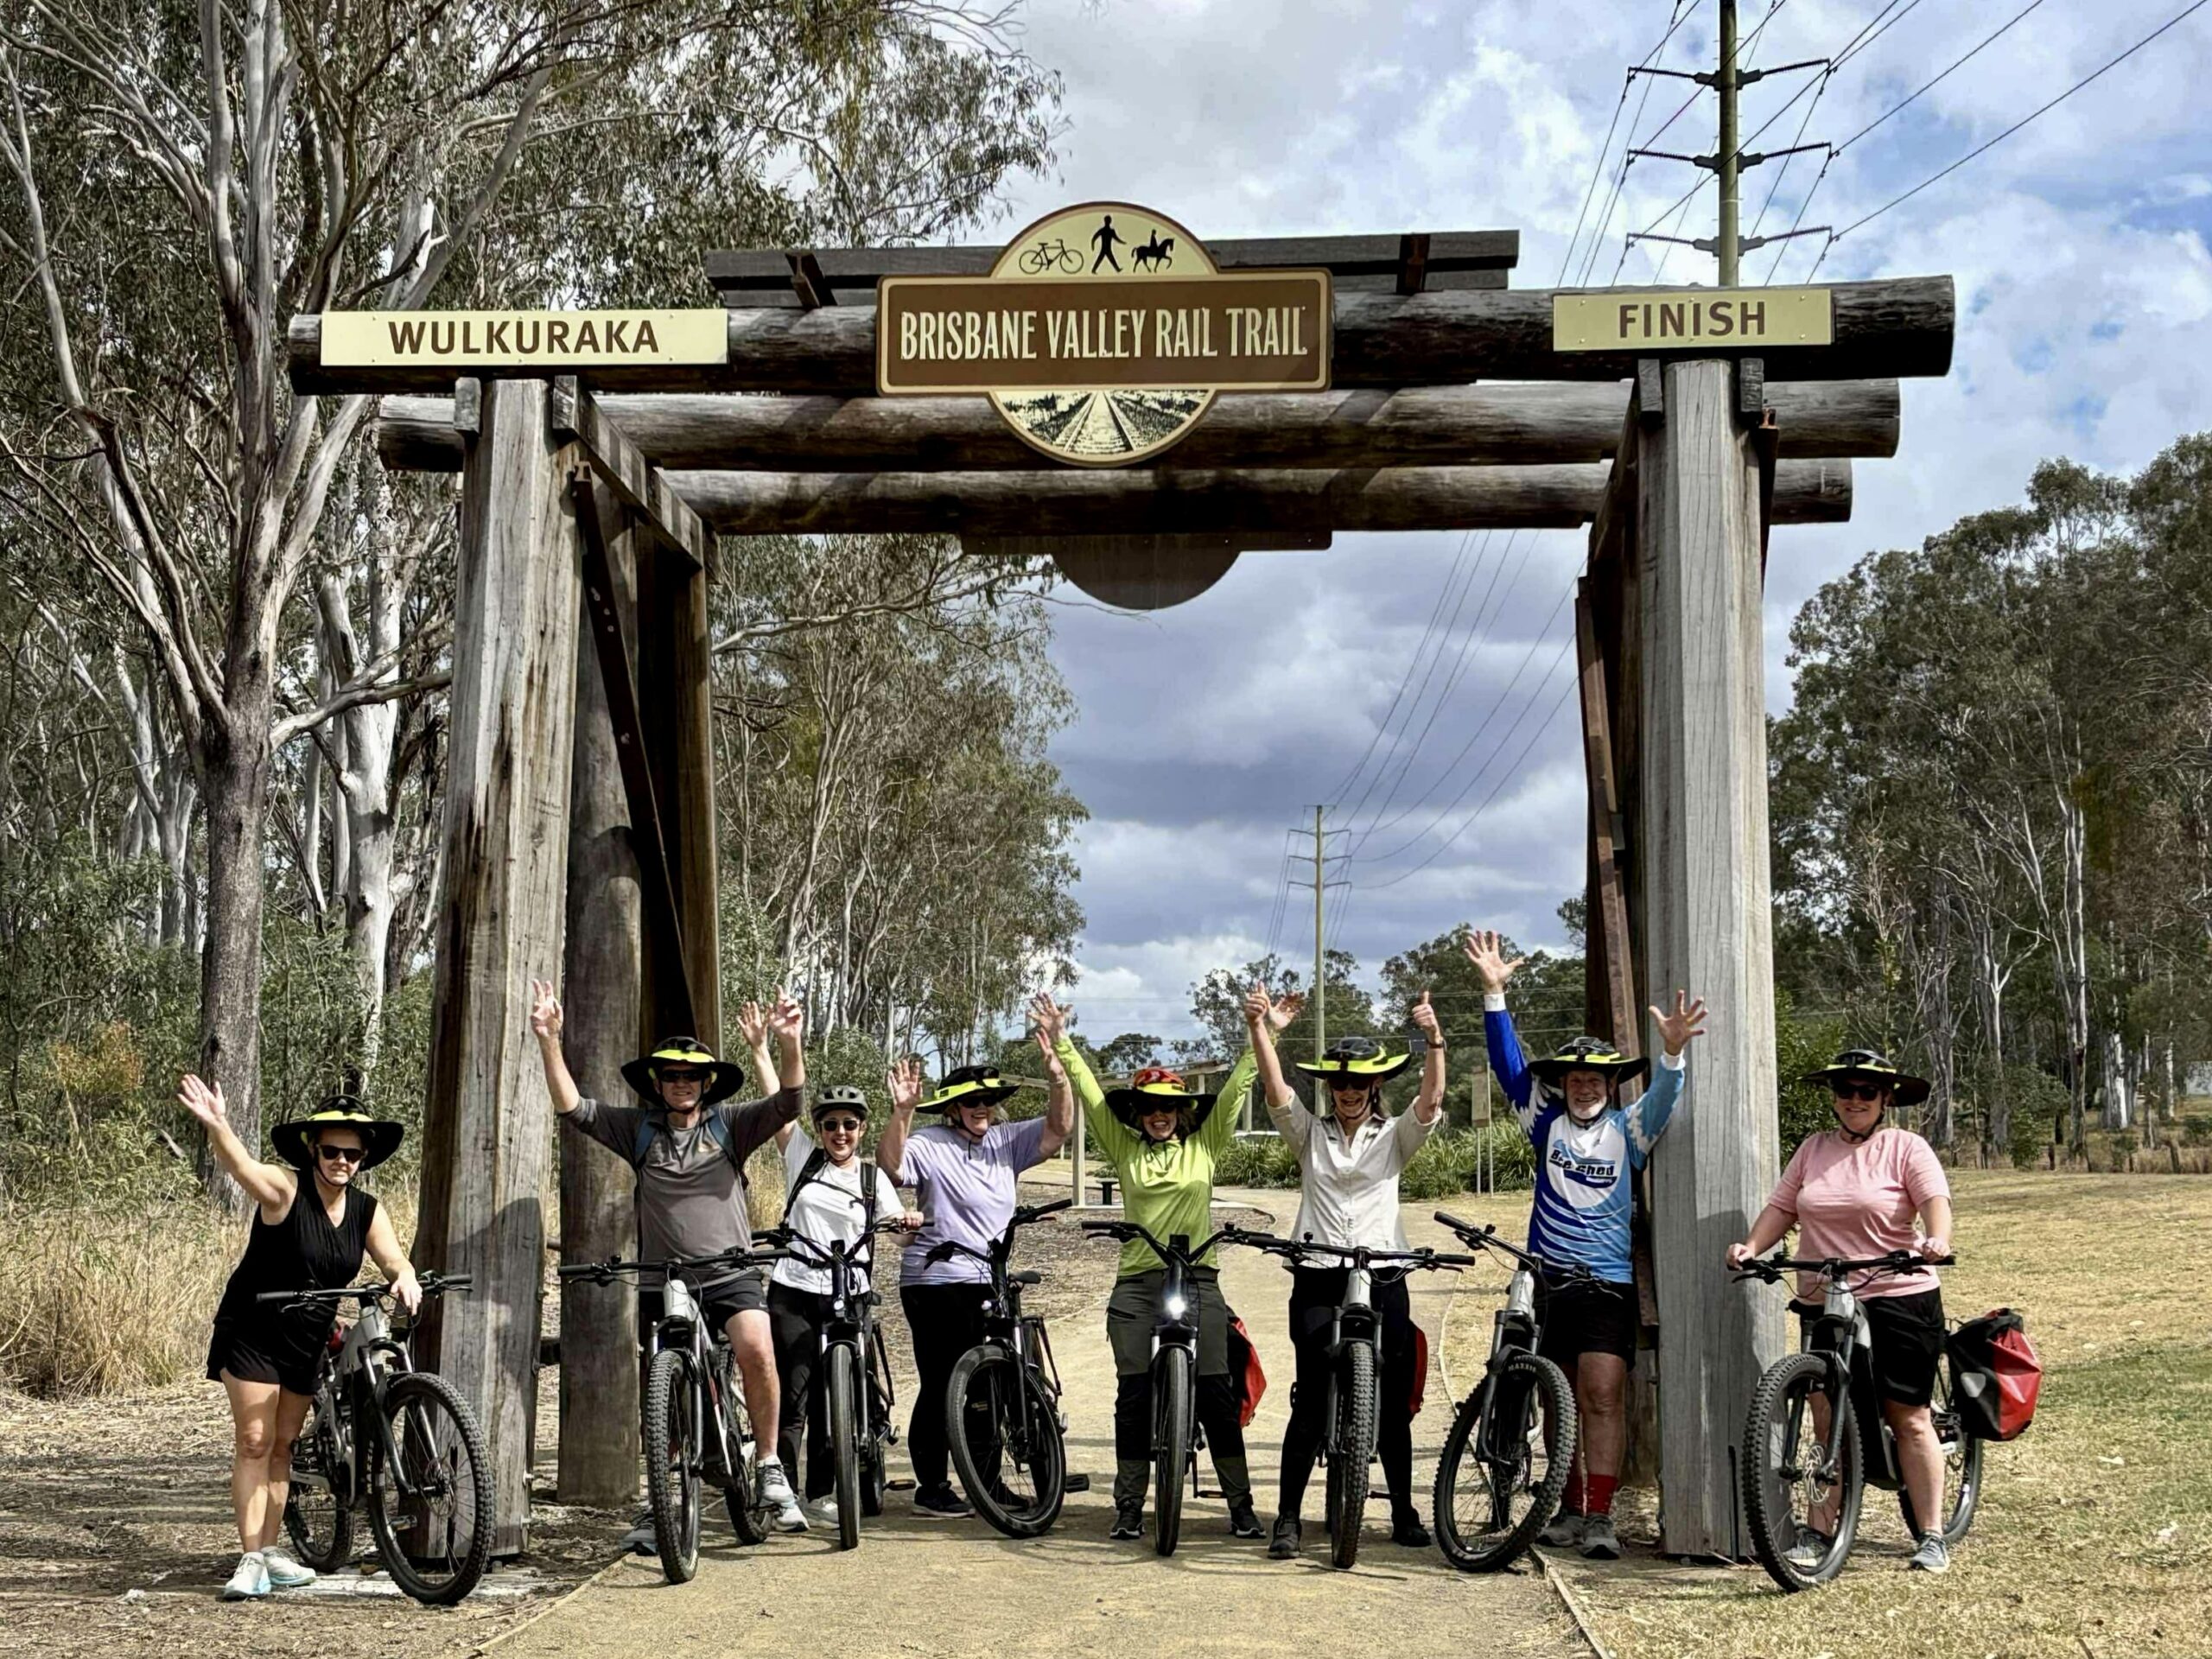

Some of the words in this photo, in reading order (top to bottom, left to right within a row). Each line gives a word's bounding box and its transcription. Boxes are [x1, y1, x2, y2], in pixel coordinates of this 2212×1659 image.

[388, 320, 659, 354] WULKURAKA
[900, 308, 1037, 360] BRISBANE
[1046, 308, 1147, 359] VALLEY
[1155, 307, 1218, 358] RAIL
[1225, 306, 1308, 357] TRAIL
[1618, 301, 1765, 338] FINISH
